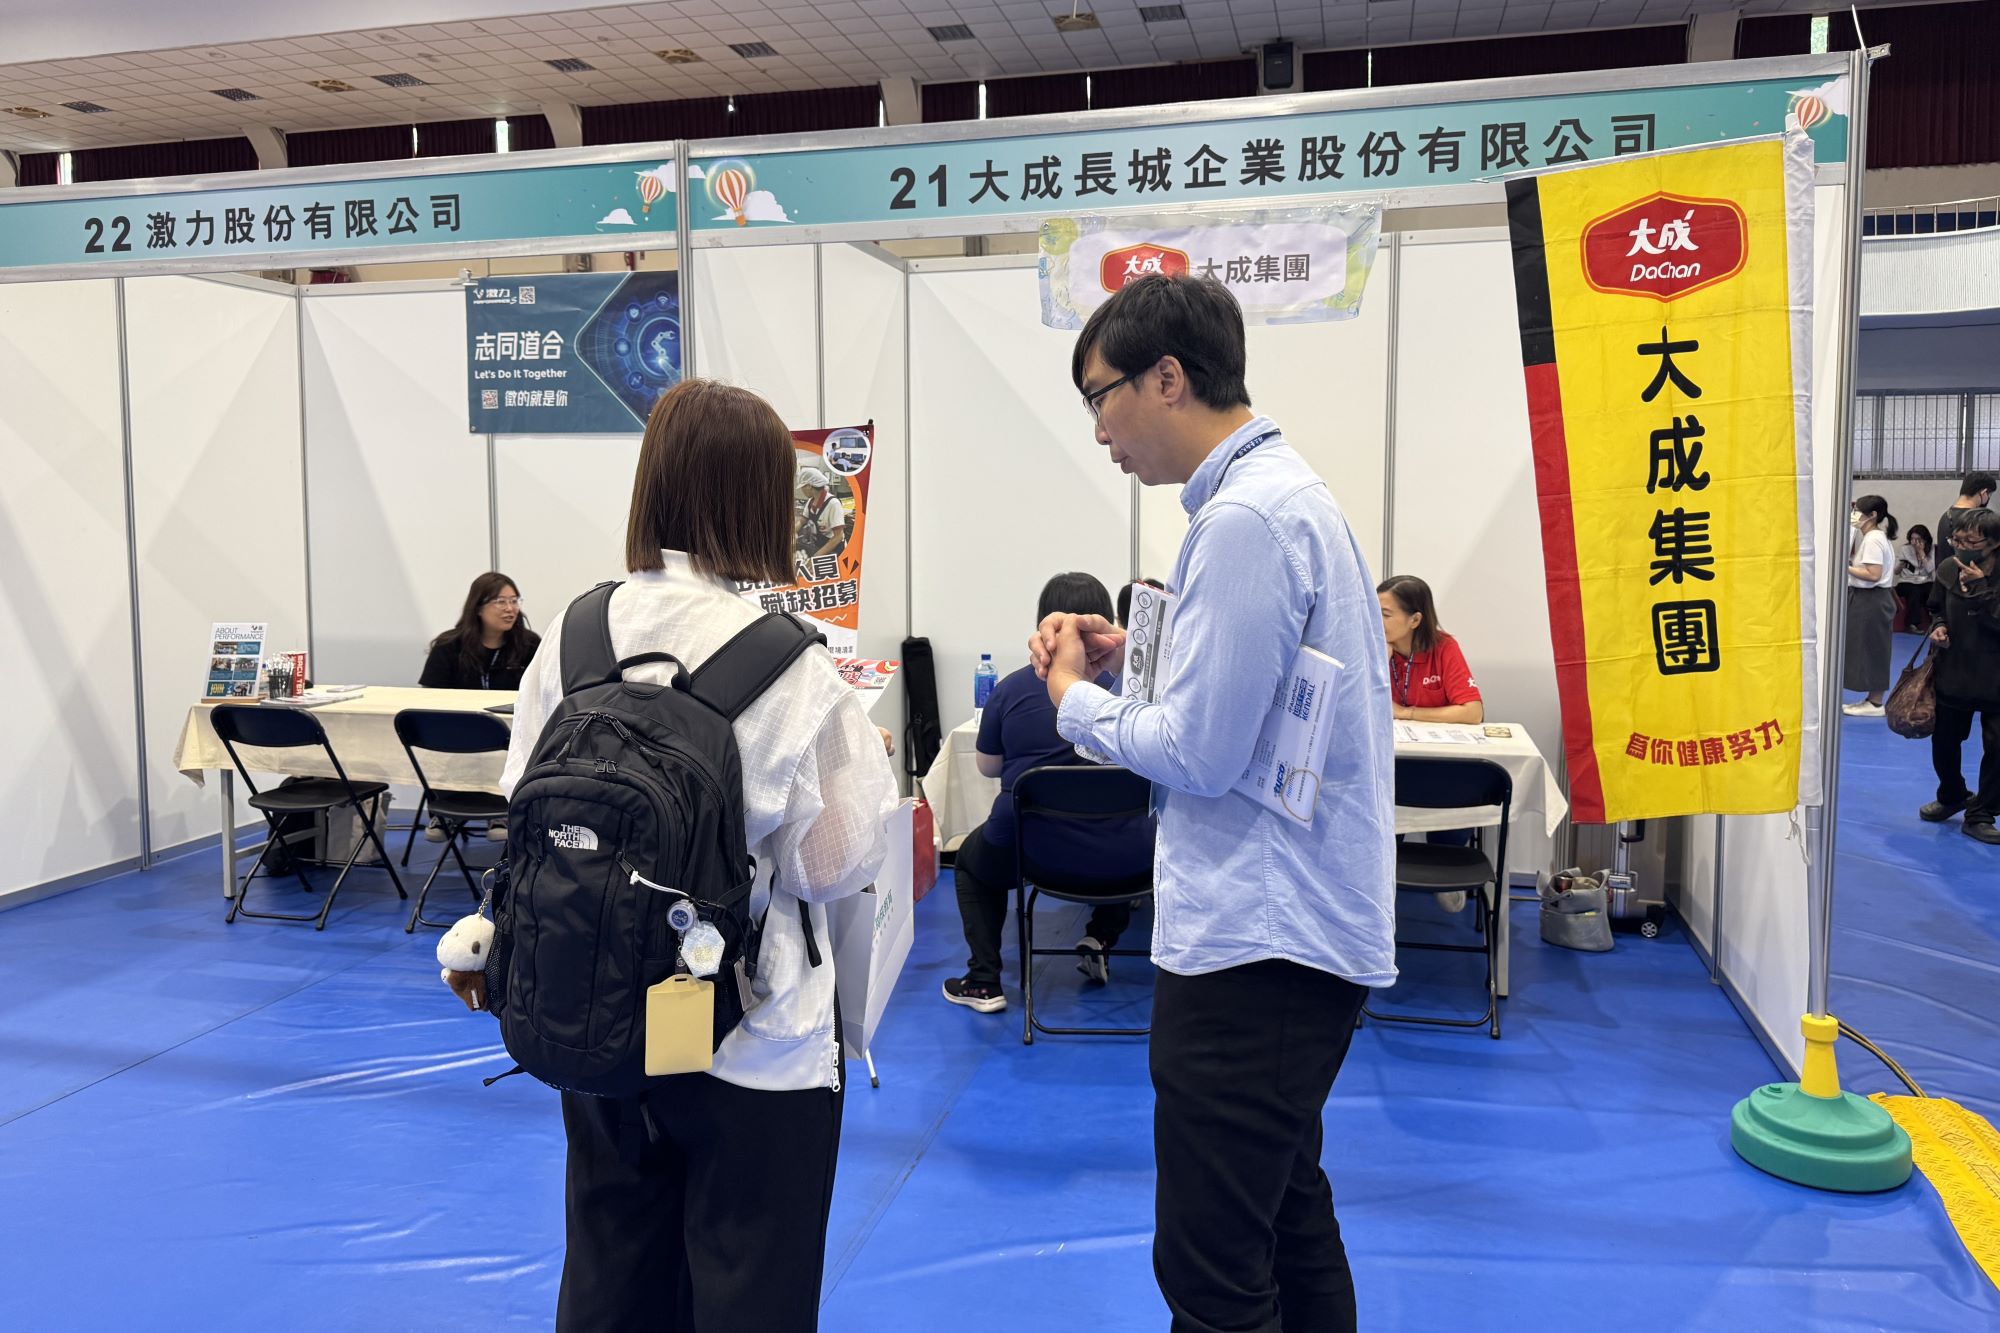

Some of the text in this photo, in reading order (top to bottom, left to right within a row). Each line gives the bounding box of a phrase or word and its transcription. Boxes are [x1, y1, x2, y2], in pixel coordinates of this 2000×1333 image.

[889, 113, 1656, 209] 21 大成長城企業股份有限公司
[84, 193, 461, 253] 22 激力股份有限公司
[1625, 209, 1699, 257] 大成
[1122, 253, 1165, 275] 大成
[1198, 253, 1311, 286] 大成集團
[1630, 261, 1700, 282] DaChan
[475, 330, 564, 361] 志同道合
[475, 368, 567, 380] Let's Do It Together
[1637, 325, 1720, 675] 大成集團
[760, 580, 857, 614] 職缺招募
[548, 828, 580, 840] NORTH
[554, 838, 580, 848] FACE
[561, 824, 580, 833] THE
